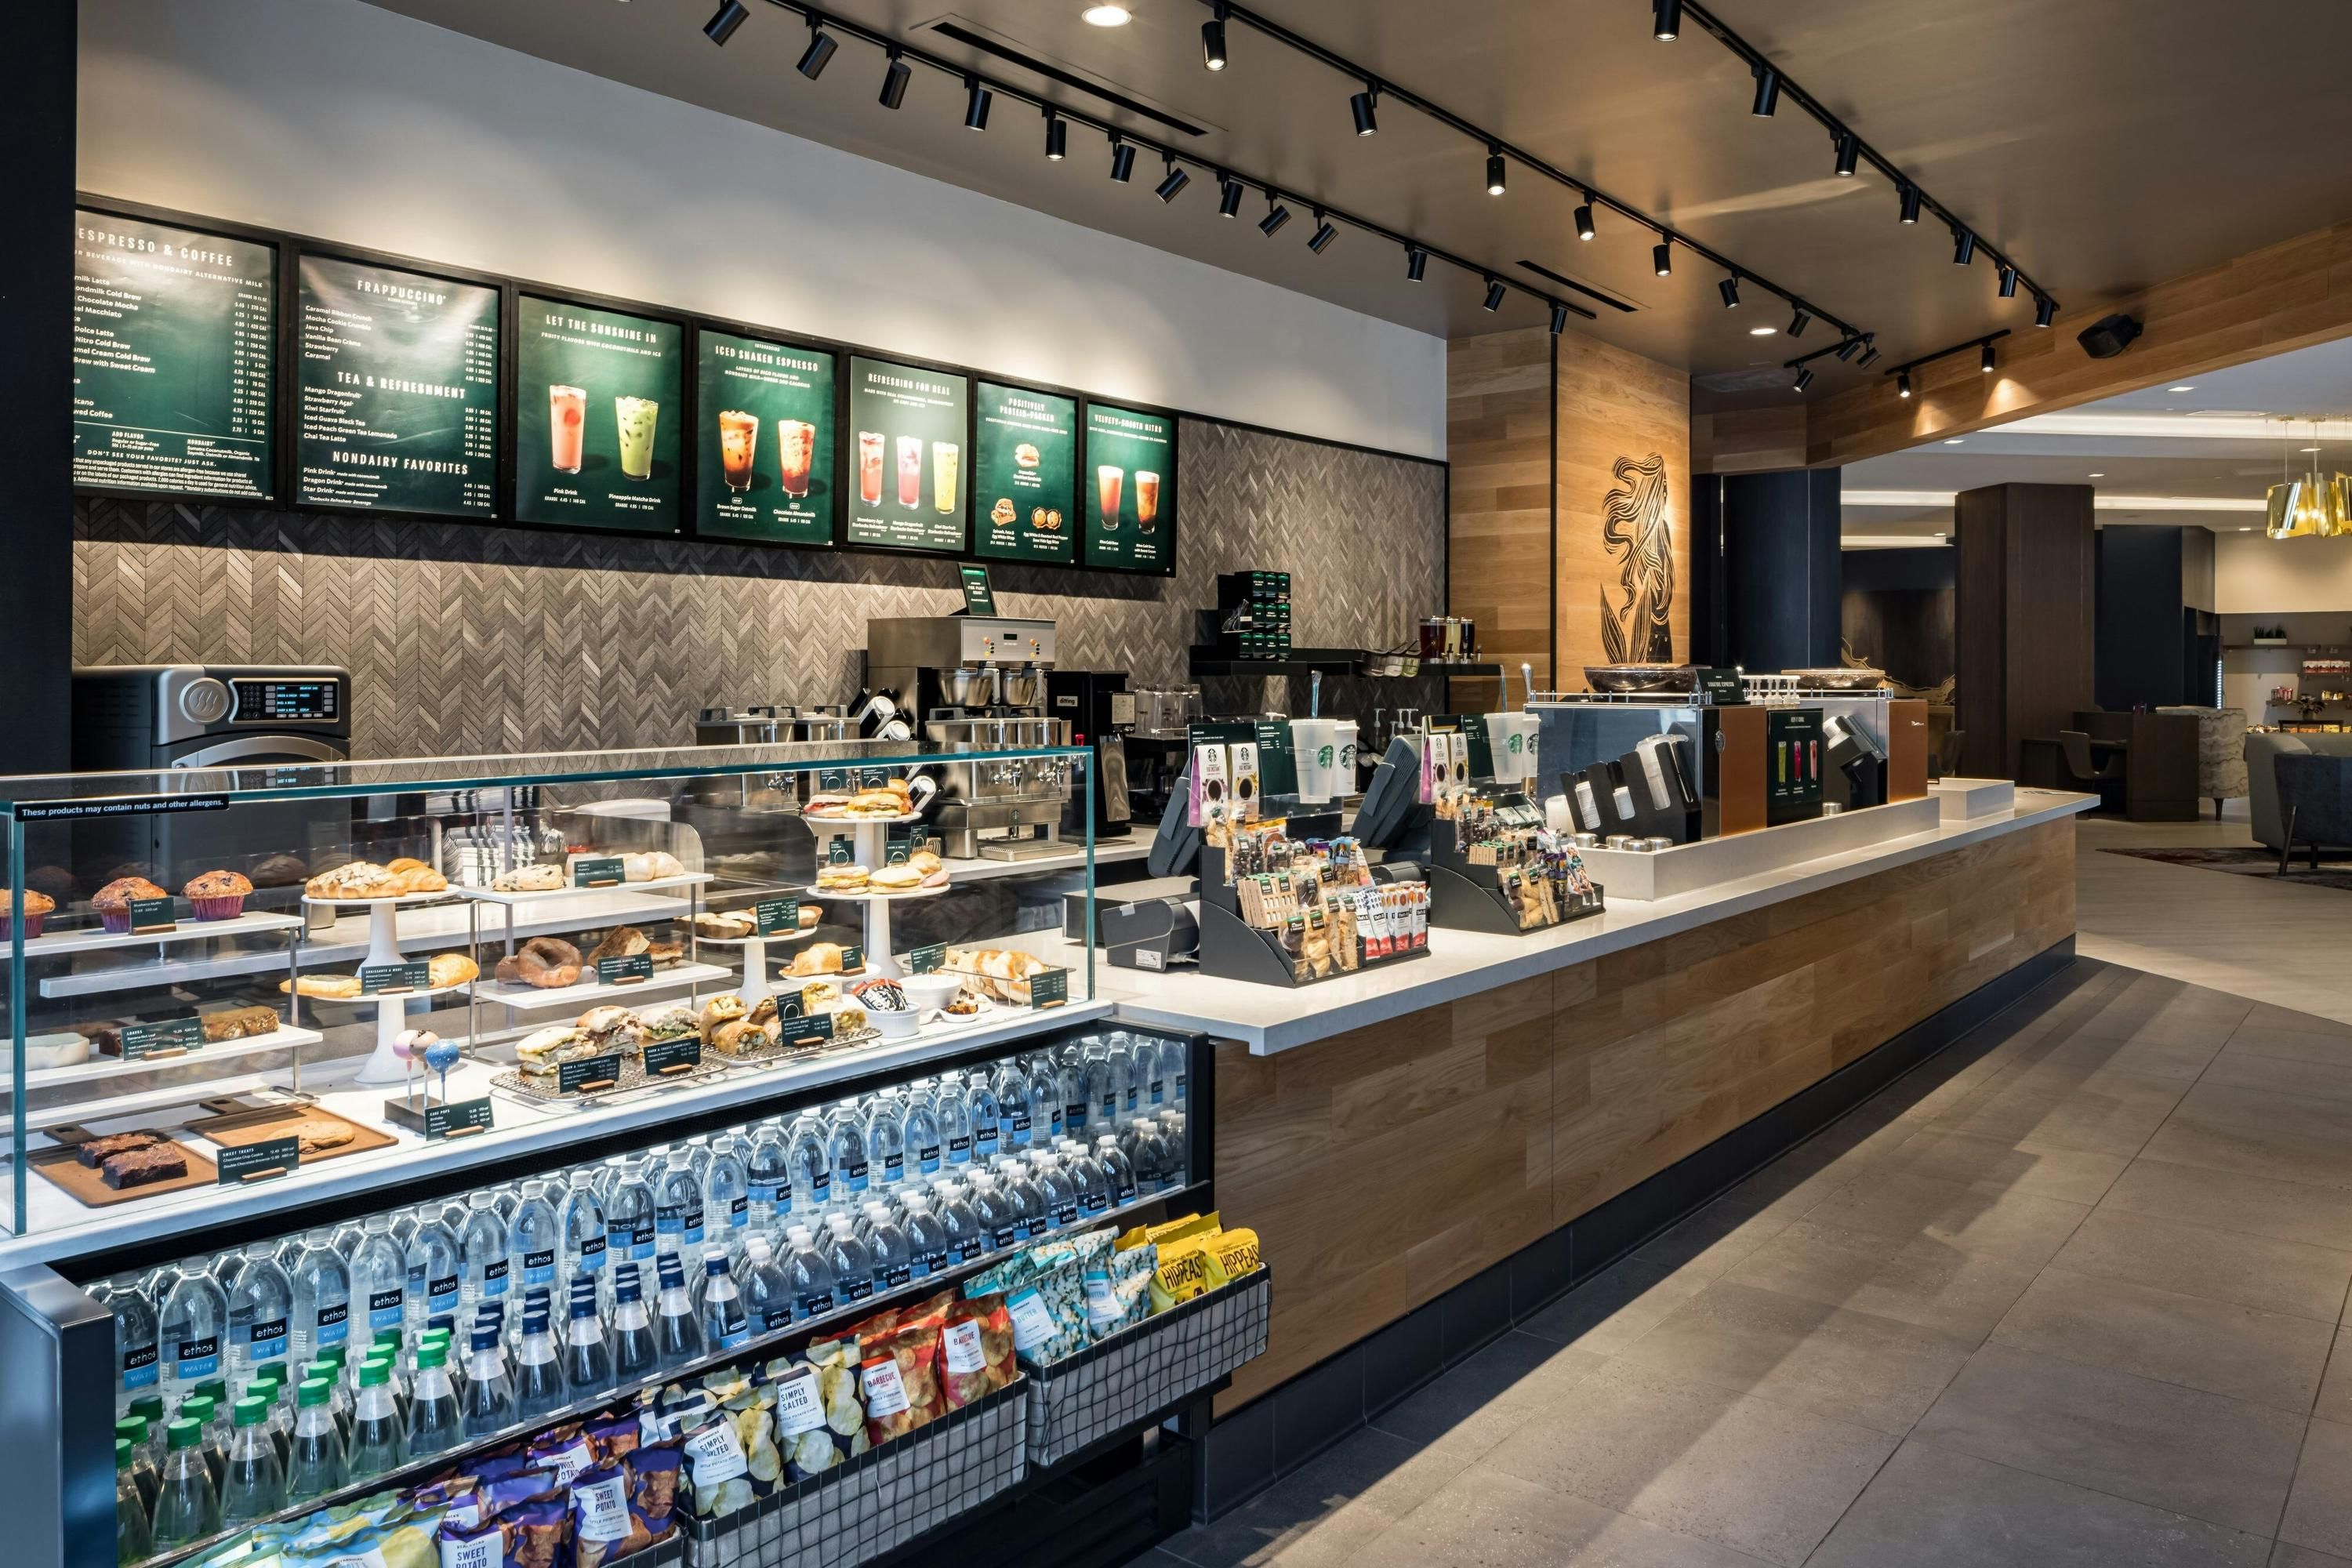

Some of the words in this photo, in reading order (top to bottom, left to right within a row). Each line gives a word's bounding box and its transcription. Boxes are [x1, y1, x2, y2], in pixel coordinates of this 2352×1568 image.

[79, 227, 155, 253] ESPRESSO
[163, 244, 173, 256] &
[181, 247, 233, 267] COFFEE
[195, 268, 243, 284] ALTERNATIVE
[245, 278, 263, 288] MILK
[124, 292, 142, 301] Brew
[78, 296, 114, 307] Chocolate
[114, 301, 139, 310] Mocha
[85, 307, 122, 318] Macchiato
[306, 305, 331, 315] Caramel
[306, 314, 326, 323] Mocha
[327, 318, 347, 327] Cookie
[306, 324, 319, 332] Java
[546, 314, 563, 327] LET
[568, 318, 586, 332] THE
[591, 323, 641, 341] SUNSHINE
[645, 332, 657, 343] IN
[305, 333, 326, 342] Vanilla
[327, 336, 342, 345] Bean
[541, 332, 561, 341] FRUITY
[561, 336, 585, 345] FLAVORS
[601, 343, 639, 354] COCONUTMILK
[305, 343, 339, 354] Strawberry
[92, 349, 114, 358] Cream
[115, 352, 131, 361] Cold
[305, 352, 331, 361] Caramel
[715, 346, 735, 358] ICED
[739, 350, 773, 365] SHAKEN
[776, 357, 818, 372] ESPRESSO
[110, 361, 132, 371] Sweet
[132, 365, 155, 373] Cream
[338, 372, 360, 385] TEA
[366, 376, 375, 387] &
[380, 379, 466, 399] REFRESHMENT
[868, 372, 913, 390] REFRESHING
[916, 382, 929, 392] FOR
[932, 385, 950, 395] REAL
[304, 386, 326, 396] Mango
[304, 395, 339, 407] Strawberry
[1008, 397, 1045, 412] POSITIVELY
[89, 409, 113, 419] Coffee
[318, 416, 338, 424] Guava
[1145, 423, 1162, 434] NITRO
[368, 430, 397, 440] Lemonade
[332, 451, 398, 468] NONDAIRY
[404, 458, 469, 476] FAVORITES
[303, 476, 325, 485] Dragon
[22, 808, 45, 817] These
[49, 806, 83, 817] products
[103, 803, 132, 812] contain
[189, 798, 224, 808] allergens.
[1016, 1120, 1030, 1129] ethos
[980, 1131, 996, 1139] ethos
[953, 1140, 968, 1149] ethos
[924, 1149, 938, 1159] ethos
[853, 1166, 867, 1176] ethos
[1121, 1188, 1134, 1196] ethos
[1091, 1200, 1105, 1208] ethos
[1062, 1213, 1076, 1221] ethos
[1033, 1223, 1046, 1233] ethos
[637, 1232, 655, 1243] ethos
[999, 1234, 1013, 1245] ethos
[586, 1240, 605, 1252] ethos
[966, 1248, 980, 1257] ethos
[528, 1253, 551, 1265] ethos
[933, 1258, 947, 1269] ethos
[1220, 1244, 1259, 1276] HIPPEAS
[489, 1265, 508, 1276] ethos
[1161, 1256, 1203, 1289] HIPPEAS
[891, 1273, 909, 1284] ethos
[434, 1281, 456, 1294] ethos
[853, 1287, 871, 1298] ethos
[374, 1294, 400, 1307] ethos
[812, 1301, 831, 1312] ethos
[323, 1308, 347, 1322] ethos
[770, 1313, 789, 1327] ethos
[1017, 1308, 1038, 1323] BUTTER
[256, 1325, 284, 1338] ethos
[183, 1342, 213, 1356] ethos
[130, 1350, 156, 1364] ethos
[867, 1372, 896, 1388] BARBECUE
[780, 1387, 806, 1402] SIMPLY
[782, 1396, 808, 1411] SALTED
[699, 1435, 726, 1452] SIMPLY
[595, 1489, 613, 1501] SWEET
[595, 1500, 616, 1513] POTATO
[457, 1546, 485, 1561] SWEET
[456, 1558, 487, 1568] POTATO
